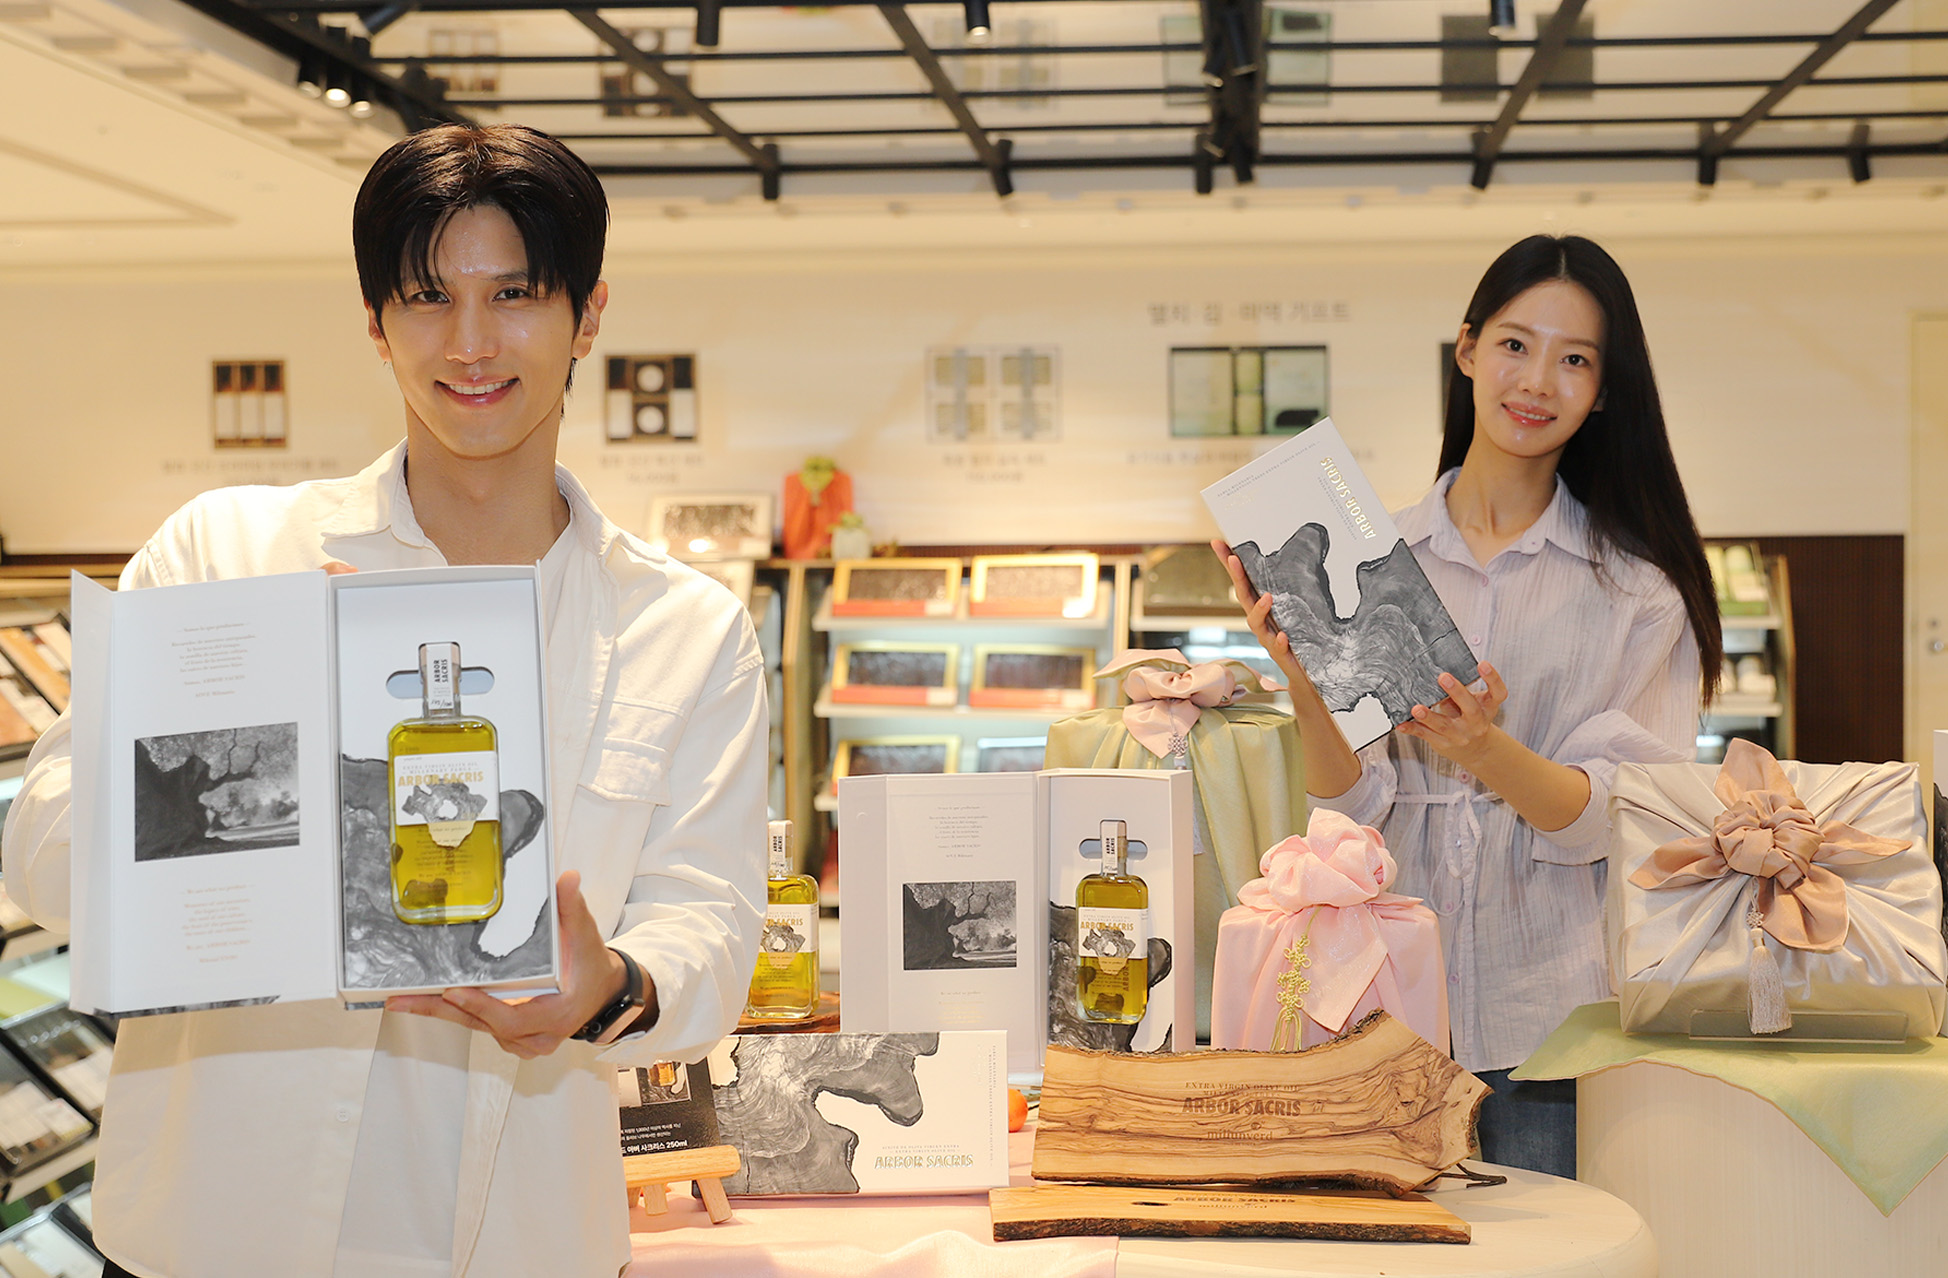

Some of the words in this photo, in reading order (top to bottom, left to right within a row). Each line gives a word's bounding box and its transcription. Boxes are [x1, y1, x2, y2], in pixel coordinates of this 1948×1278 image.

[1320, 457, 1350, 498] SACRIS
[1346, 497, 1376, 540] ARBOR
[398, 774, 440, 787] ARBOR
[443, 771, 484, 784] SACRIS
[1080, 922, 1107, 931] ARBOR
[1109, 922, 1134, 931] SACRIS
[1182, 1097, 1240, 1114] ARBOR
[1244, 1100, 1301, 1117] SACRIS
[640, 1142, 665, 1151] 사크리스
[666, 1140, 688, 1149] 250ml
[874, 1155, 923, 1169] ARBOR
[926, 1154, 974, 1168] SACRIS
